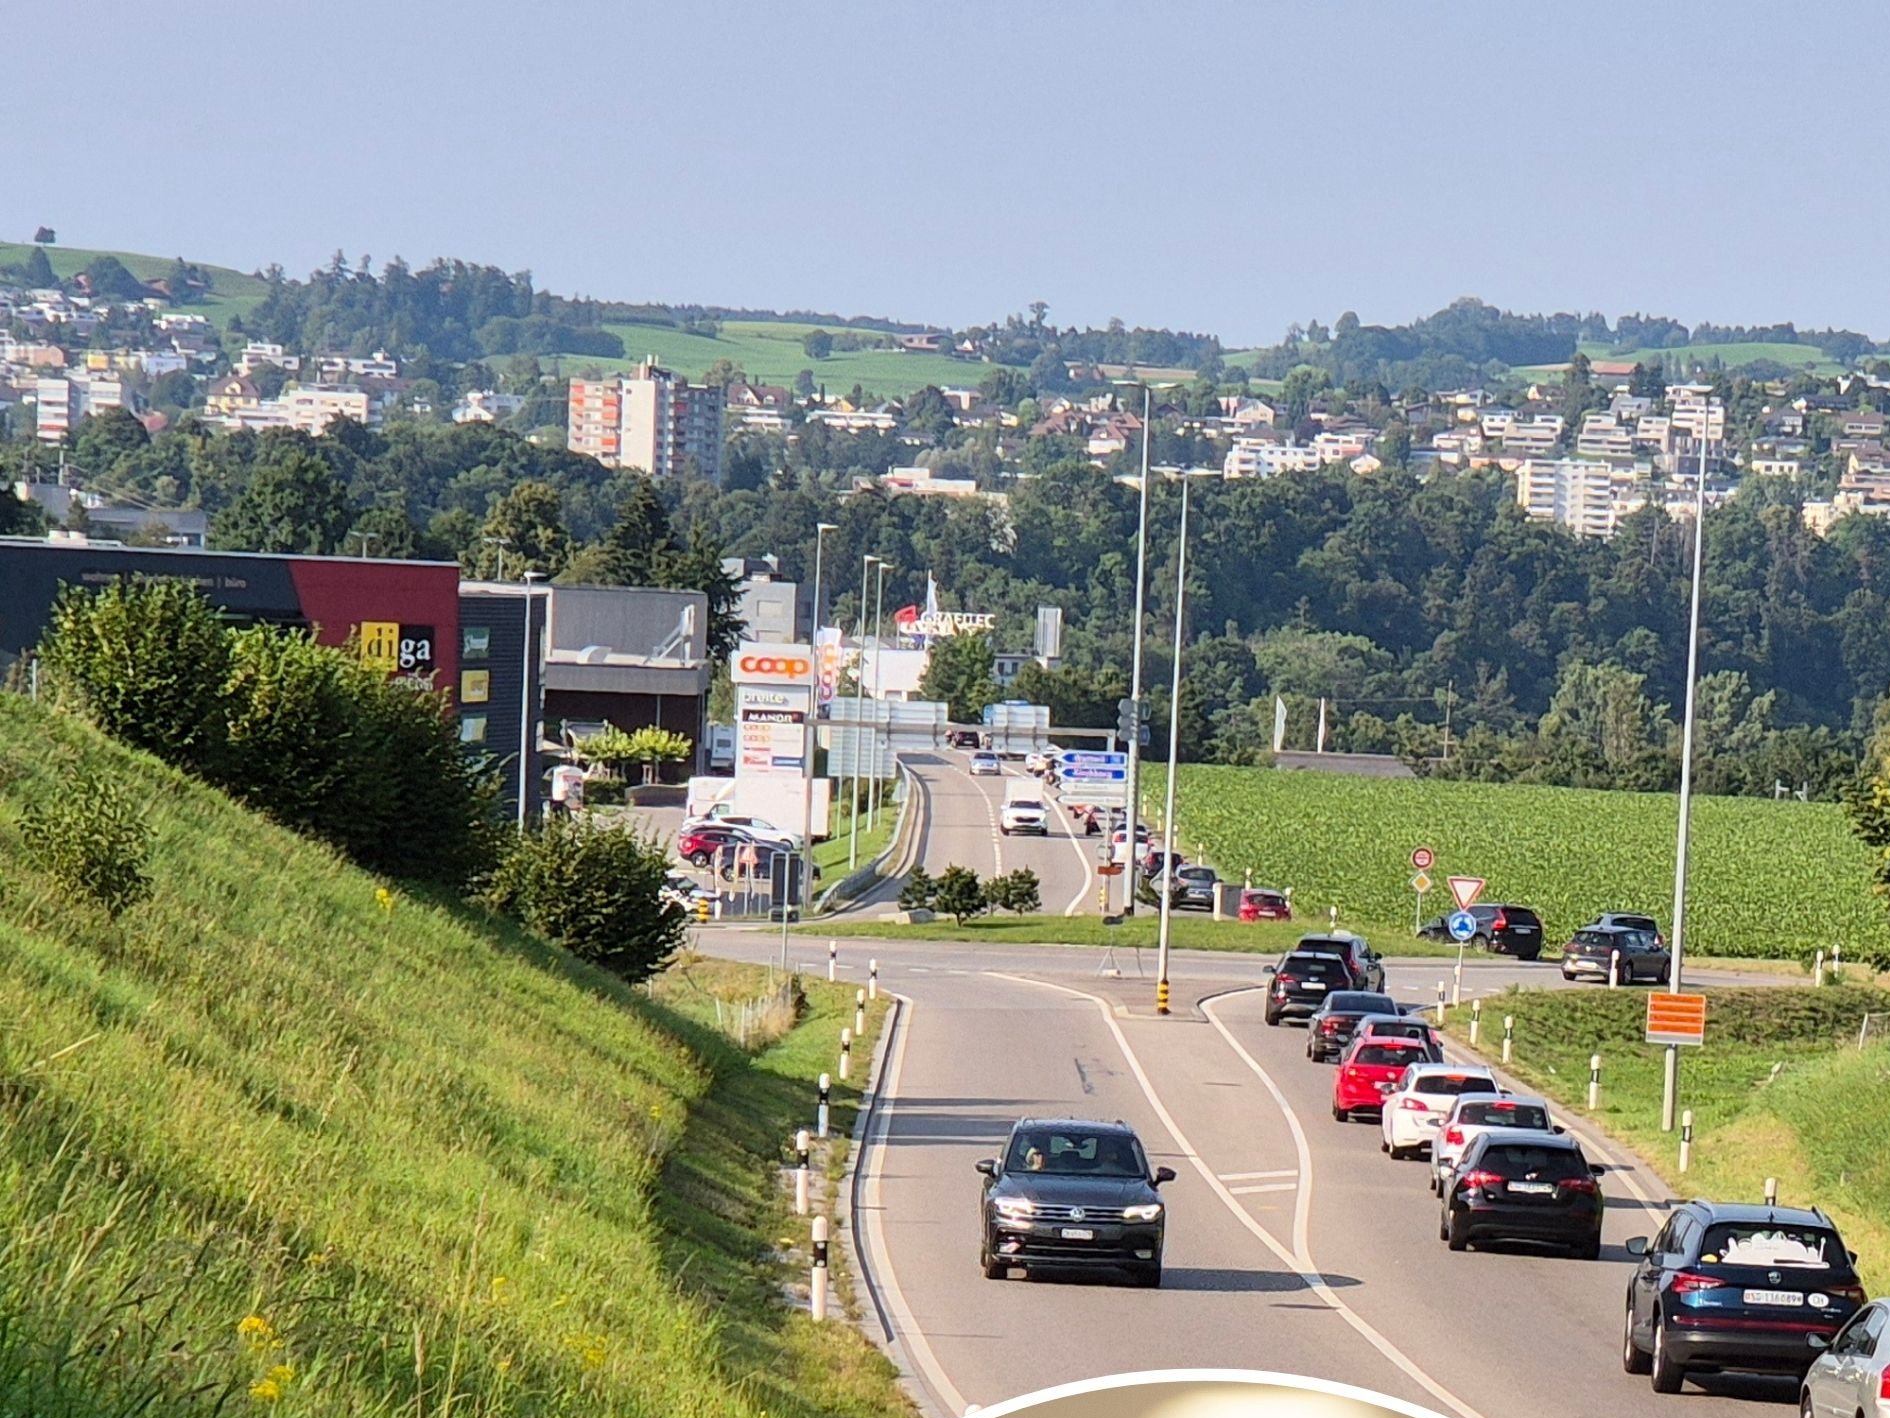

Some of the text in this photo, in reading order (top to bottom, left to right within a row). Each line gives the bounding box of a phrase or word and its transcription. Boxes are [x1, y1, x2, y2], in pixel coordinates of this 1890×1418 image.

[366, 627, 432, 669] diga
[740, 656, 809, 679] coop
[748, 711, 793, 723] MANOR
